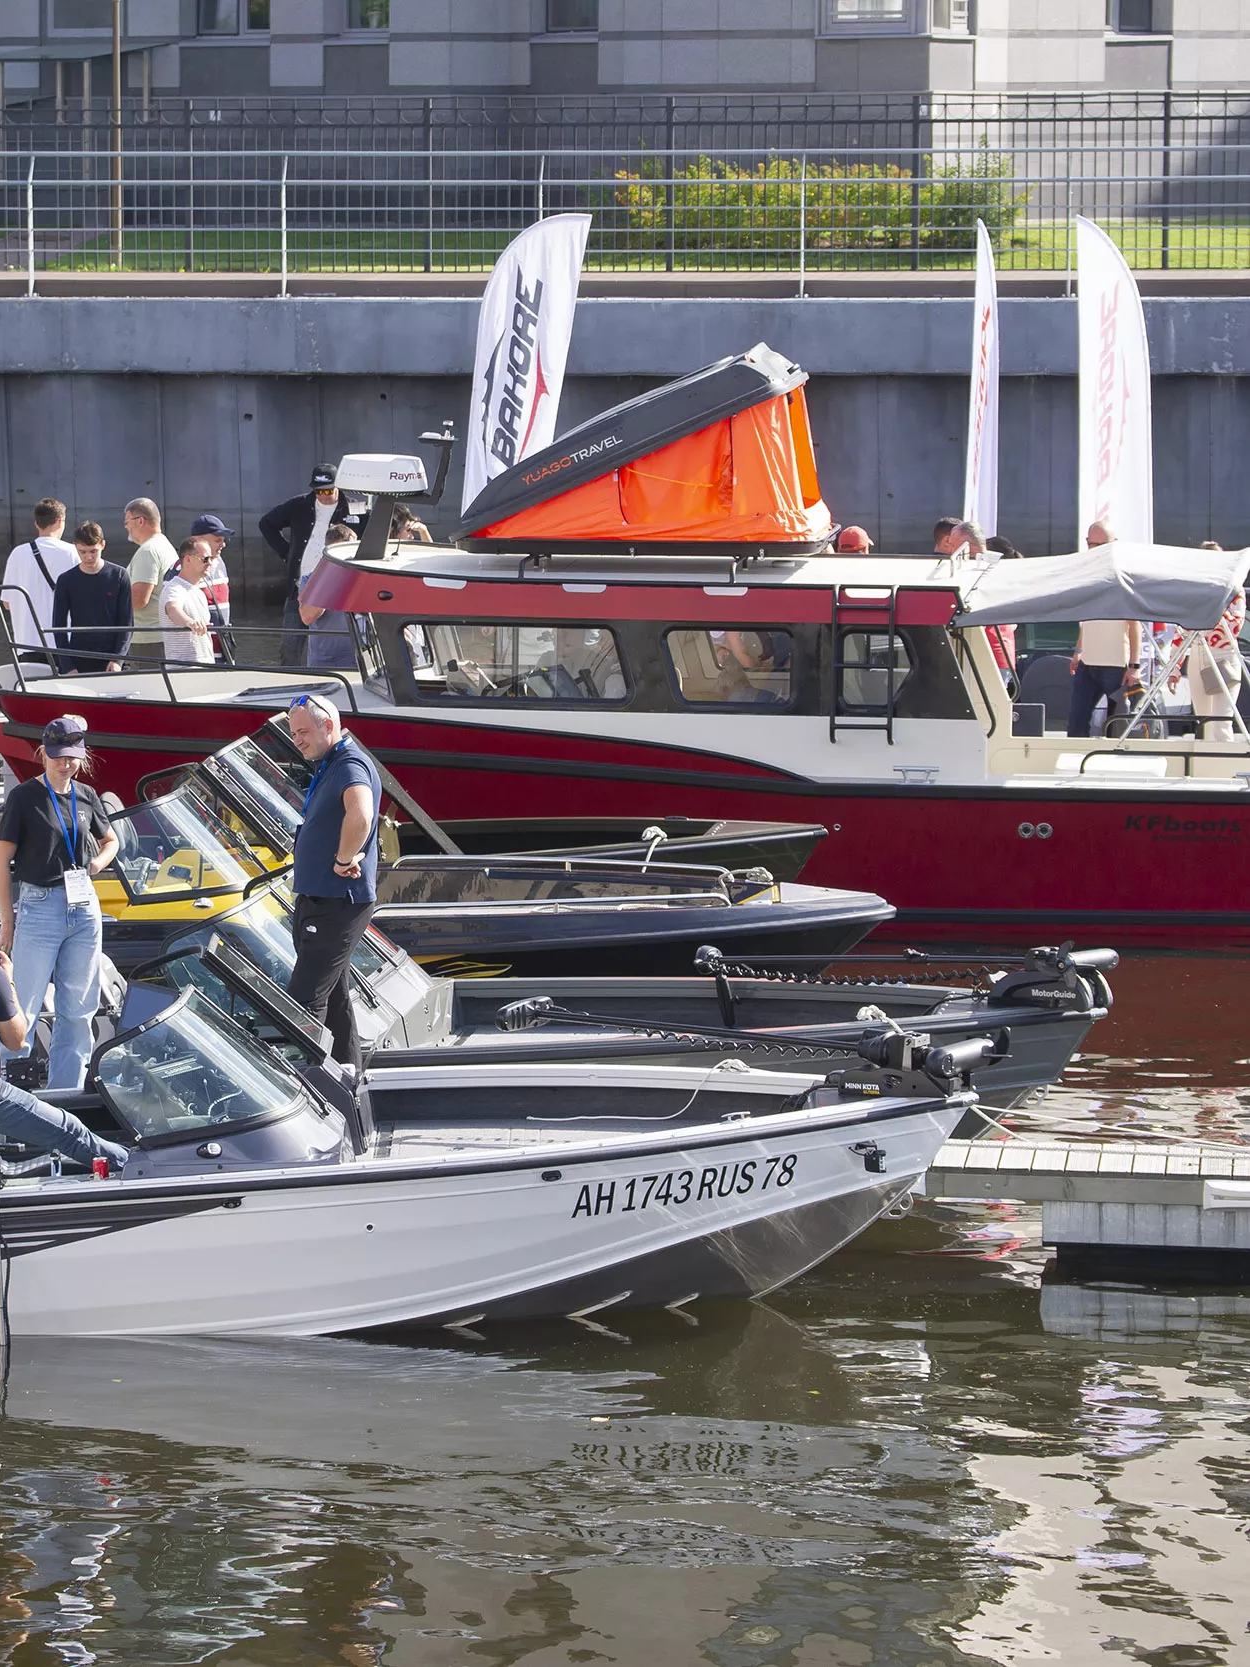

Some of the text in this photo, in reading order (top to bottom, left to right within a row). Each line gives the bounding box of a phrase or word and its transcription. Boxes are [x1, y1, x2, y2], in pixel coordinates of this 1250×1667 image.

[1031, 988, 1076, 999] MotorGuide
[845, 1082, 880, 1091] MINN KOTA
[571, 1154, 798, 1218] AH 1743 RUS 78
